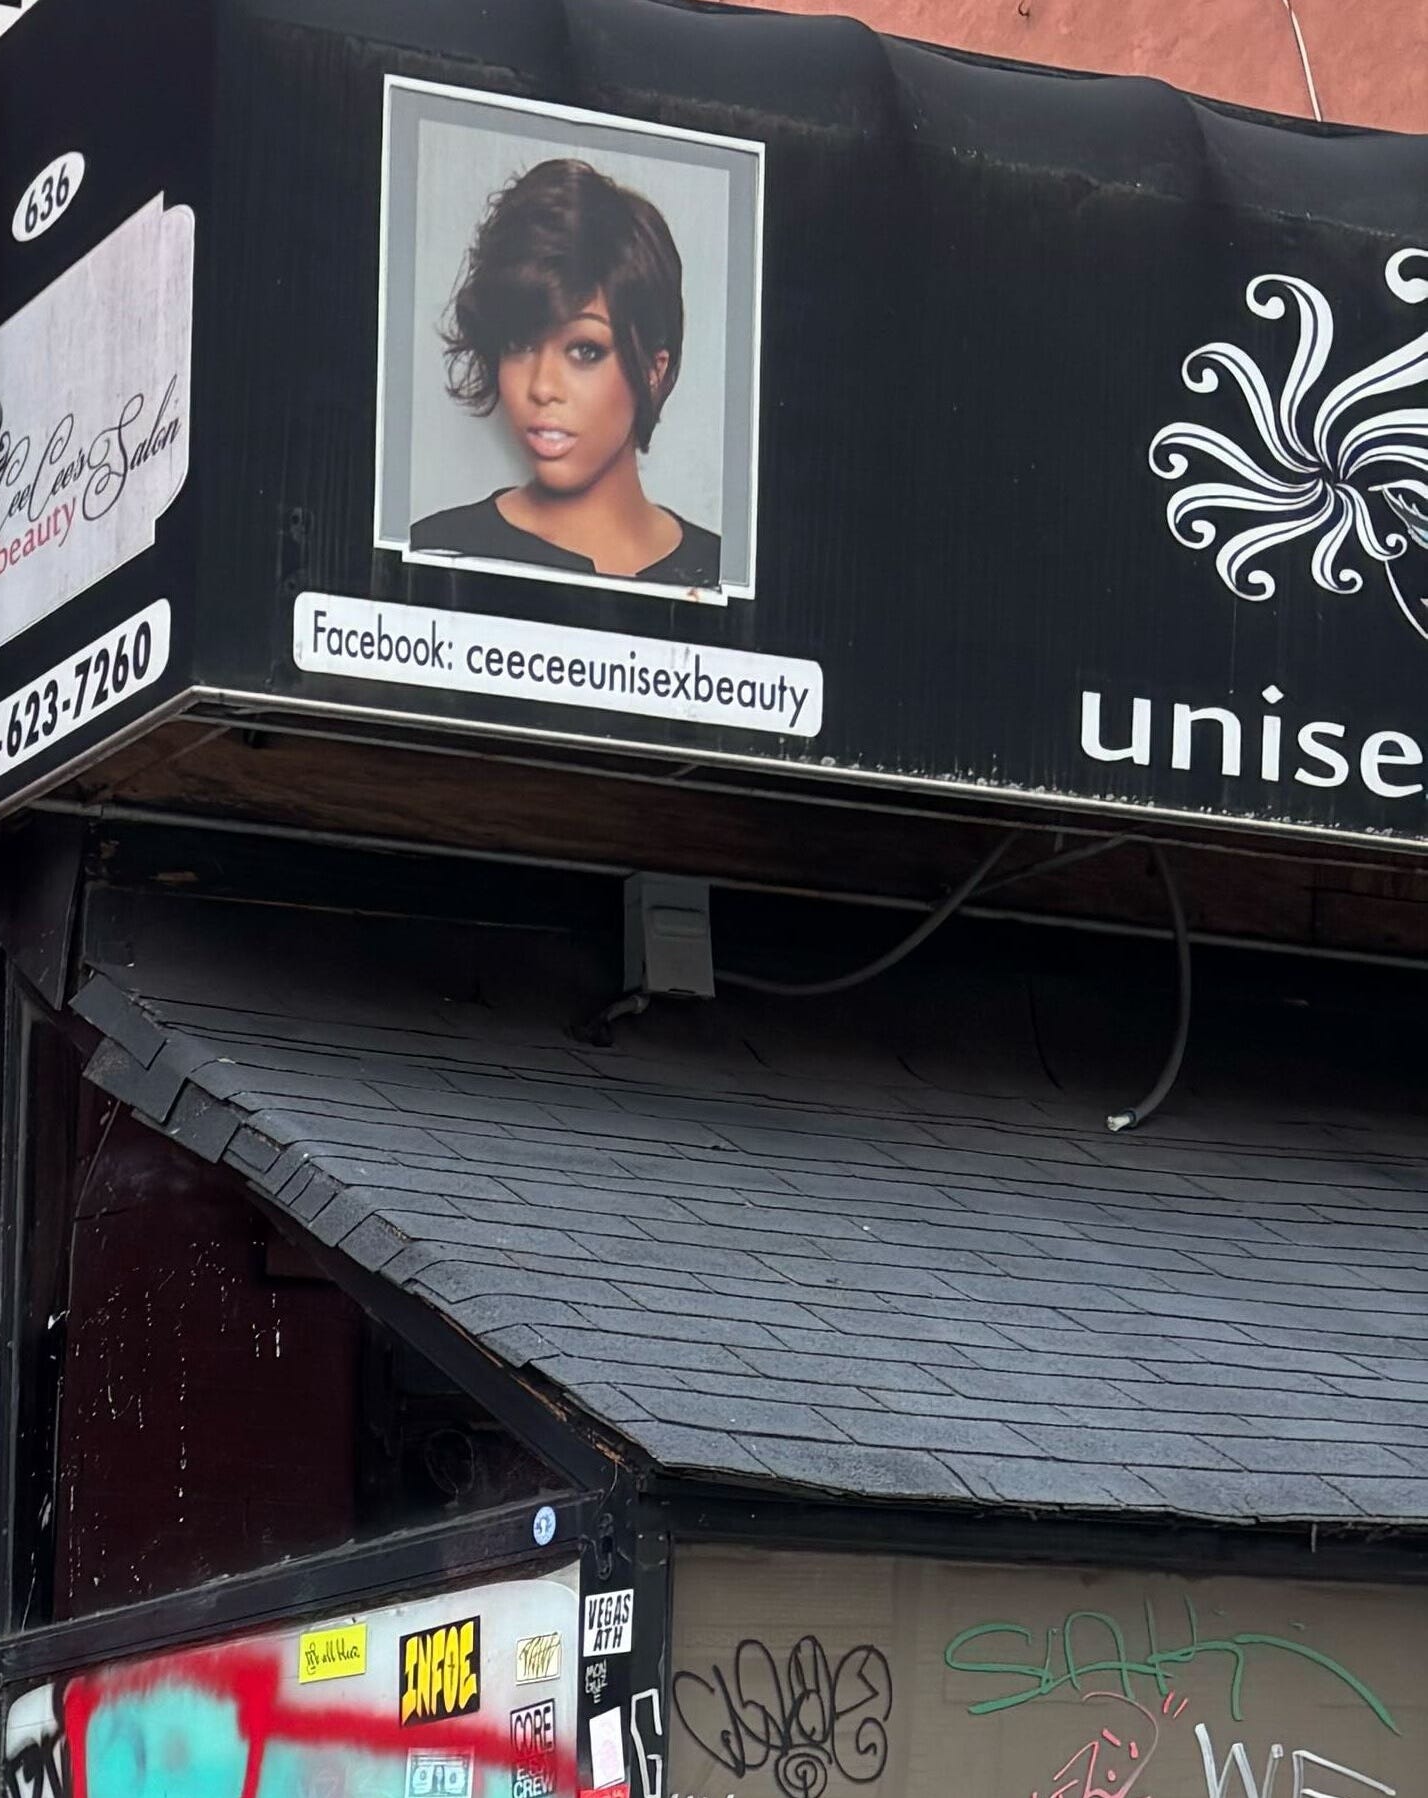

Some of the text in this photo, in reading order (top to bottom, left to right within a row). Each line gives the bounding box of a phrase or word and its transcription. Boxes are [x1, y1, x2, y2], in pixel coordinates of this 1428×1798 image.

[23, 161, 71, 235] 636
[82, 374, 183, 522] Salon
[311, 609, 810, 720] Facebook: ceeceeunisexbeauty
[1080, 683, 1428, 799] unise
[587, 1592, 632, 1632] VEGAS
[592, 1625, 625, 1652] ATH
[400, 1620, 479, 1726] INFOE
[513, 1705, 555, 1753] CORE
